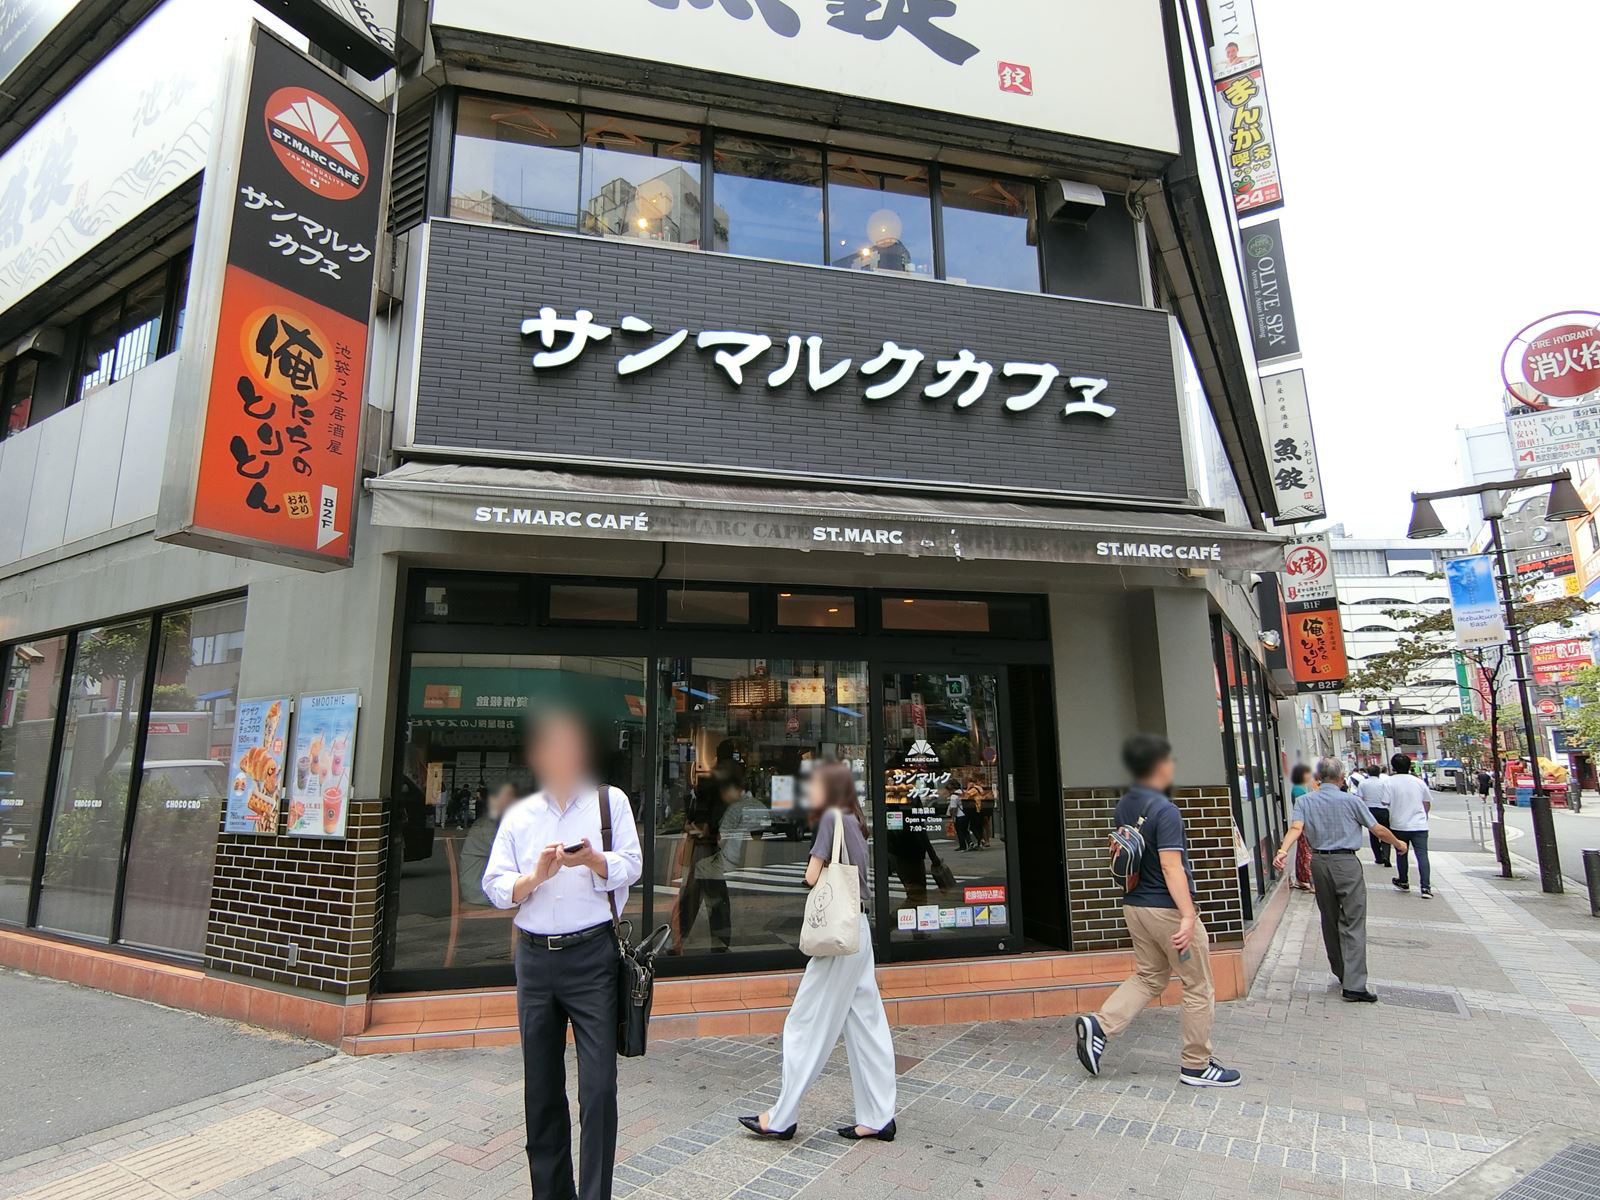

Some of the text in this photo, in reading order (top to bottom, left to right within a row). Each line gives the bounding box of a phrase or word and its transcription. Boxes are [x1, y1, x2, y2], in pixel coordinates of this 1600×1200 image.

[1223, 76, 1262, 153] まんが
[273, 127, 361, 186] ST.MARC CAFÉ
[1230, 145, 1272, 168] 喫茶
[1235, 188, 1264, 208] 24
[240, 185, 372, 263] サンマルク
[1257, 256, 1285, 347] OLIVE SPA
[1531, 328, 1595, 350] FIRE HYDRANT
[1528, 339, 1600, 383] 消火栓
[256, 313, 323, 478] 俺たちの
[326, 342, 352, 456] 池袋っ子居酒屋
[1541, 421, 1574, 437] You
[230, 375, 284, 514] とりとん
[1273, 437, 1308, 491] 魚錠
[1302, 439, 1316, 484] うおじょう
[321, 497, 335, 530] B2F
[475, 507, 649, 532] ST.MARC CAFÉ
[812, 525, 904, 545] ST.MARC
[1096, 541, 1174, 559] ST.MARC
[1175, 543, 1221, 561] CAFÉ
[1317, 681, 1338, 689] B2F
[311, 695, 346, 708] SMOOTHIE
[892, 771, 952, 784] サンマルク
[165, 800, 201, 809] CHOCO CRO
[905, 816, 920, 824] Open
